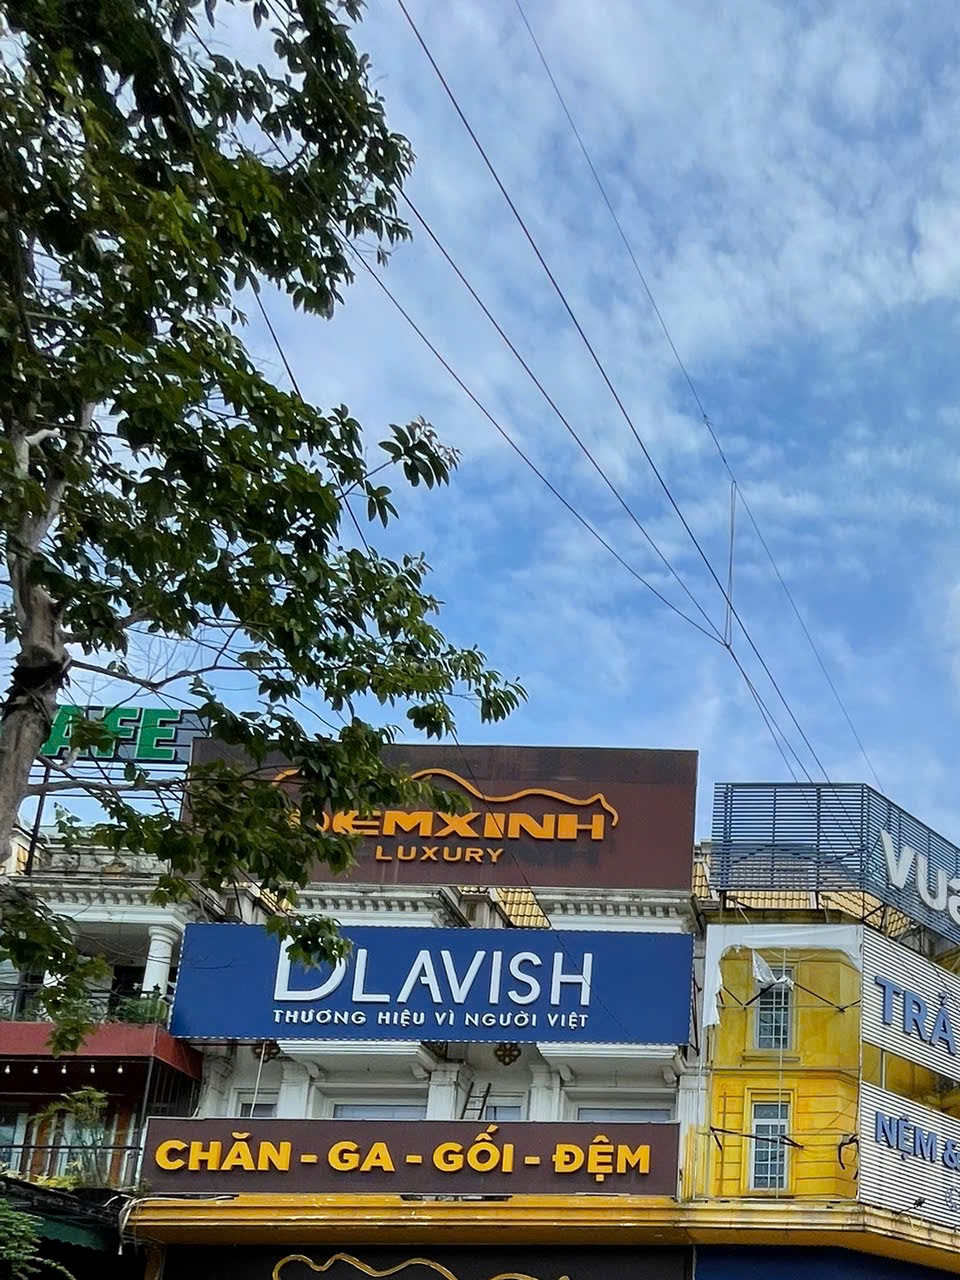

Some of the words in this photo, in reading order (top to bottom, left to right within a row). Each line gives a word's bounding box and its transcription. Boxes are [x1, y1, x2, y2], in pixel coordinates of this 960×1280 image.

[40, 704, 182, 760] AFE
[286, 809, 605, 840] EMXINH
[375, 845, 504, 864] LUXURY
[273, 935, 593, 1006] DLAVISH
[273, 1008, 367, 1027] THƯƠNG
[378, 1008, 426, 1028] HIỆU
[435, 1008, 455, 1027] VÌ
[464, 1008, 537, 1028] NGƯỜI
[547, 1010, 589, 1029] VIỆT
[874, 975, 956, 1057] TRẢ
[154, 1131, 292, 1173] CHĂN
[327, 1140, 396, 1174] GA
[432, 1124, 515, 1174] GỐI
[552, 1135, 651, 1182] ĐỆM
[875, 1111, 937, 1163] NỆM
[942, 1138, 960, 1172] &
